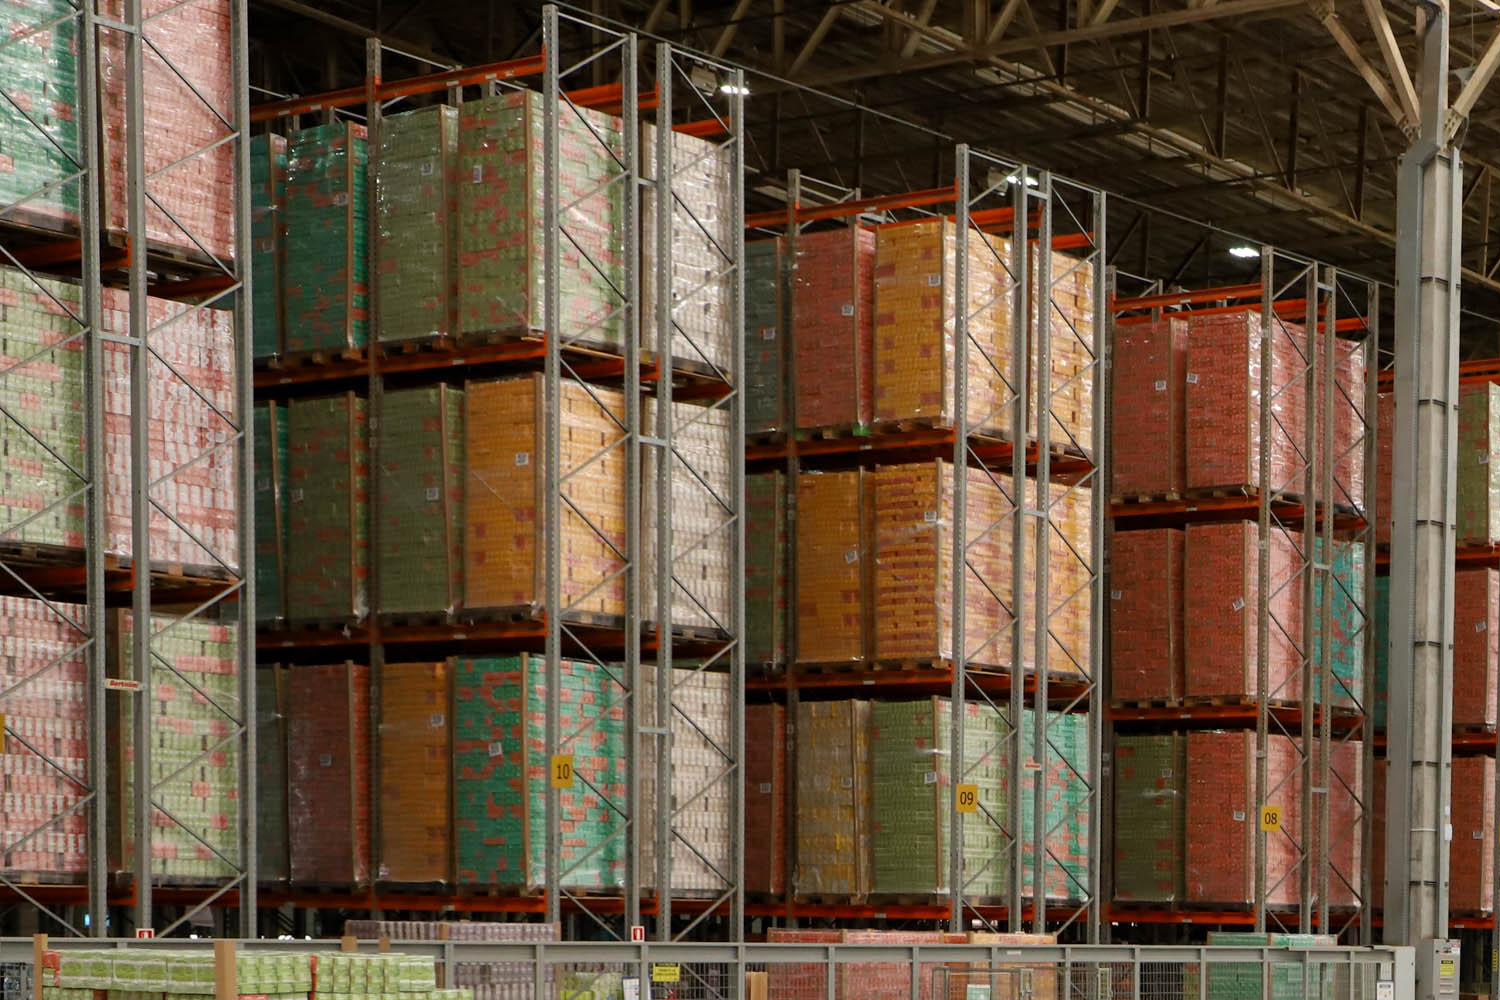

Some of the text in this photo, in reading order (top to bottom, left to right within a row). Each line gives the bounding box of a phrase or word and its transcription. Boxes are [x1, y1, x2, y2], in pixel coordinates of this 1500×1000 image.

[557, 763, 569, 779] 10
[960, 791, 973, 805] 09
[1264, 812, 1277, 824] 08
